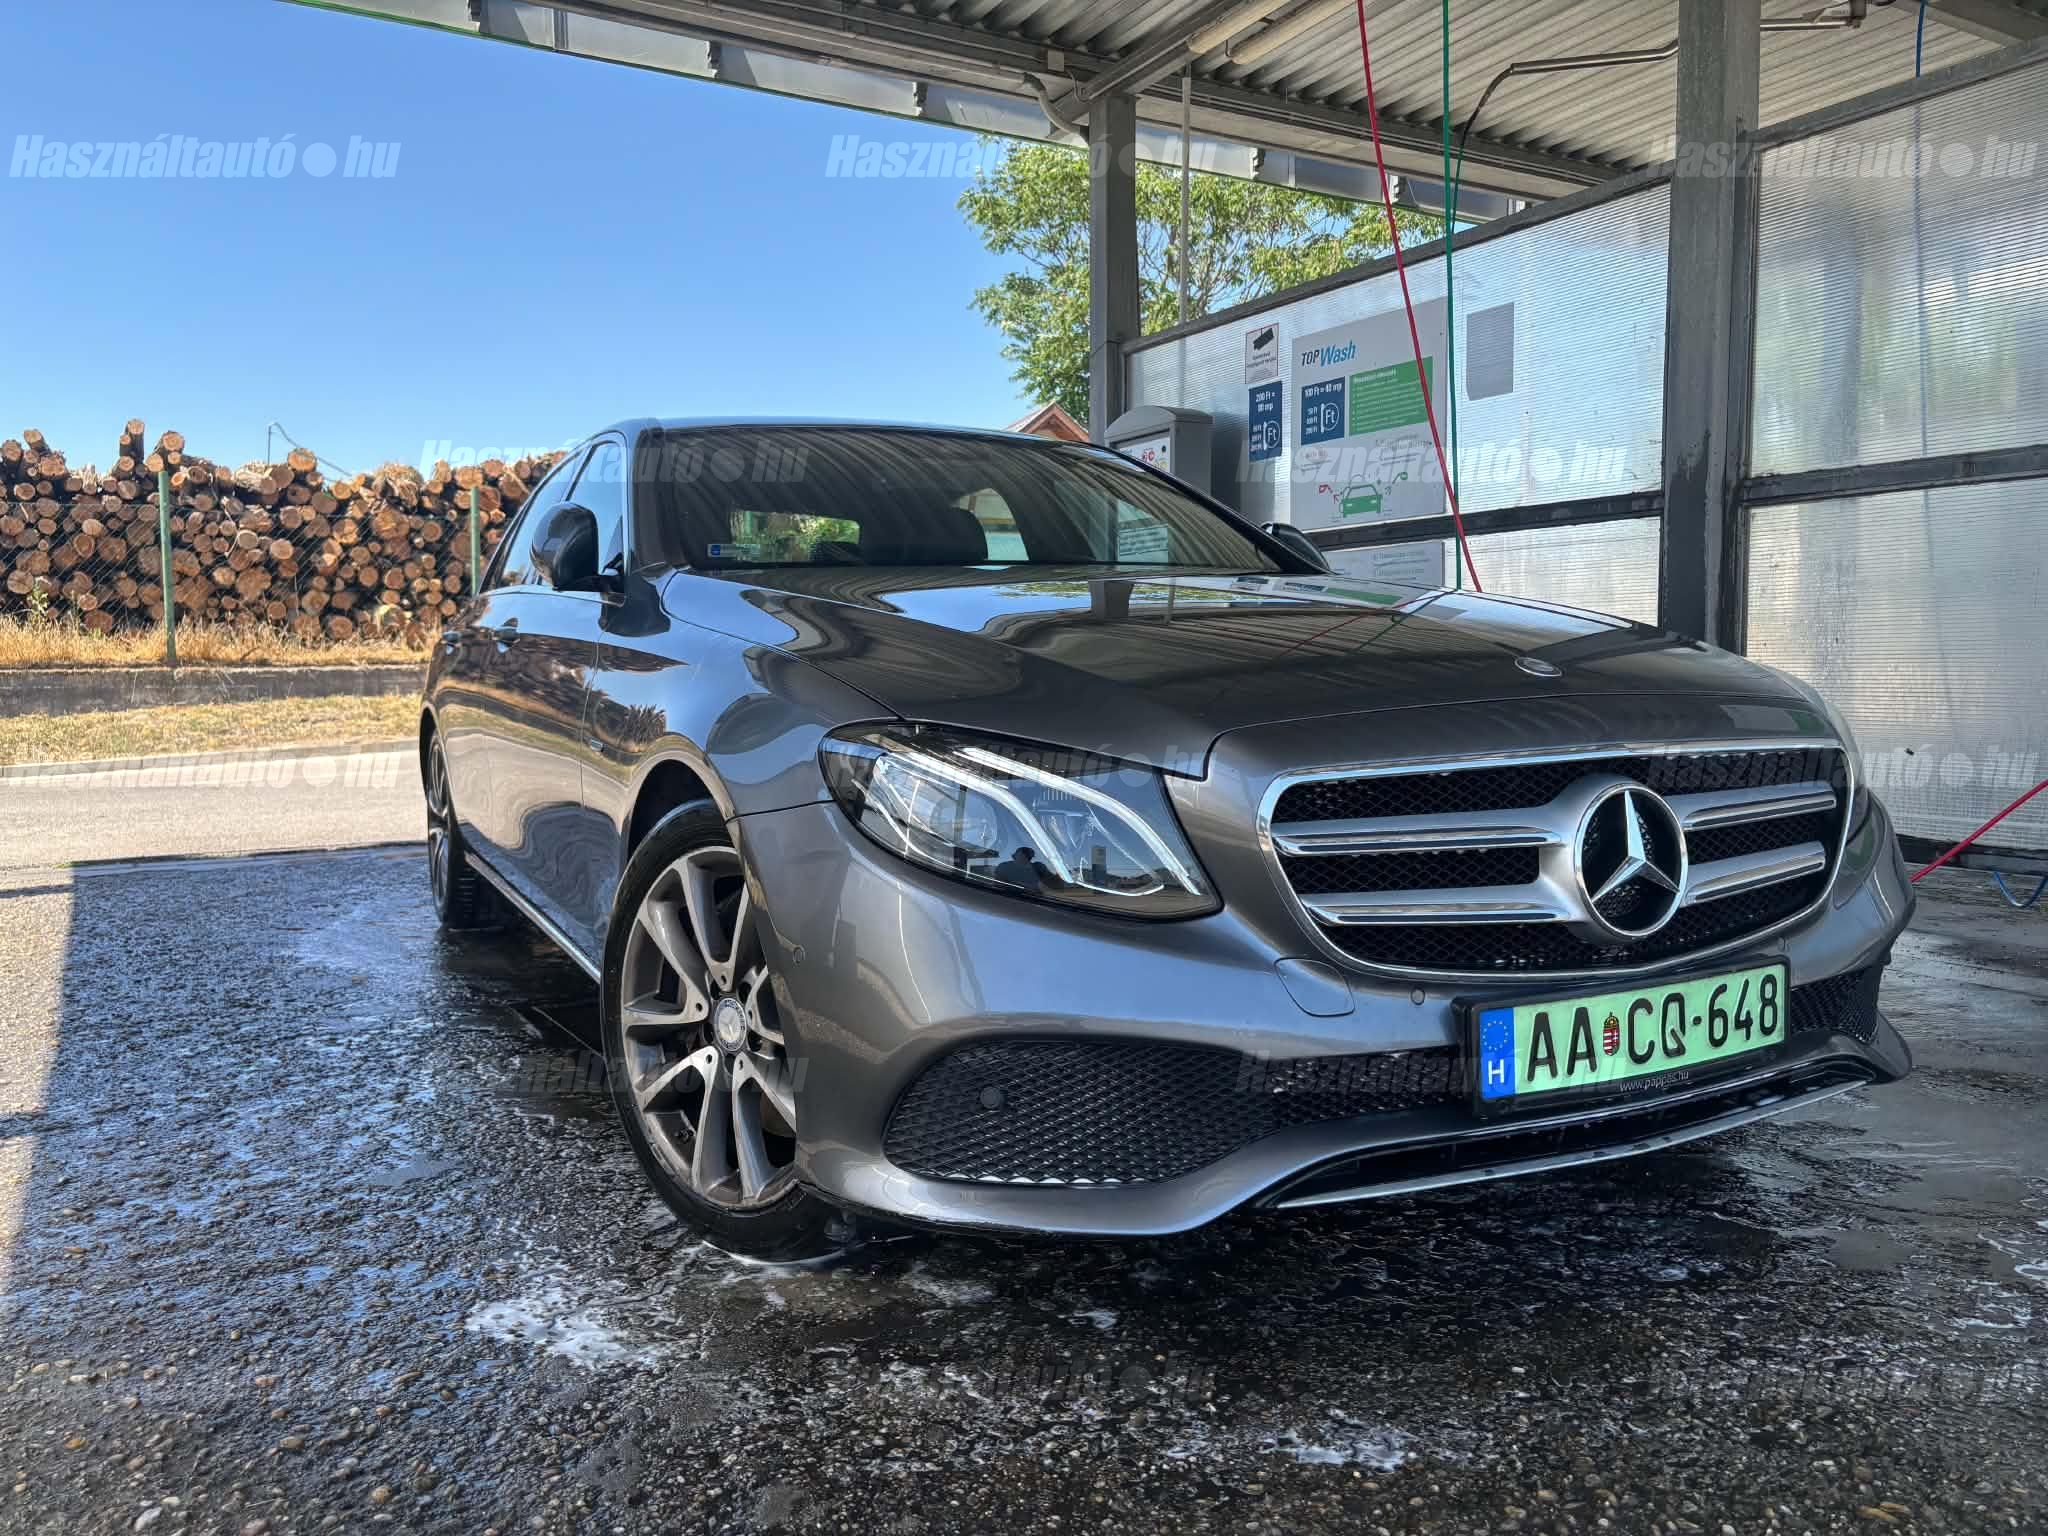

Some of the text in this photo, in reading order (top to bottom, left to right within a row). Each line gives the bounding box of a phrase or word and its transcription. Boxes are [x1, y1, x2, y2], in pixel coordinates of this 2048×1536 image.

[1325, 409, 1335, 424] Ft
[1267, 427, 1277, 443] Ft
[1527, 974, 1778, 1082] AA CQ-648
[1488, 1059, 1504, 1085] H
